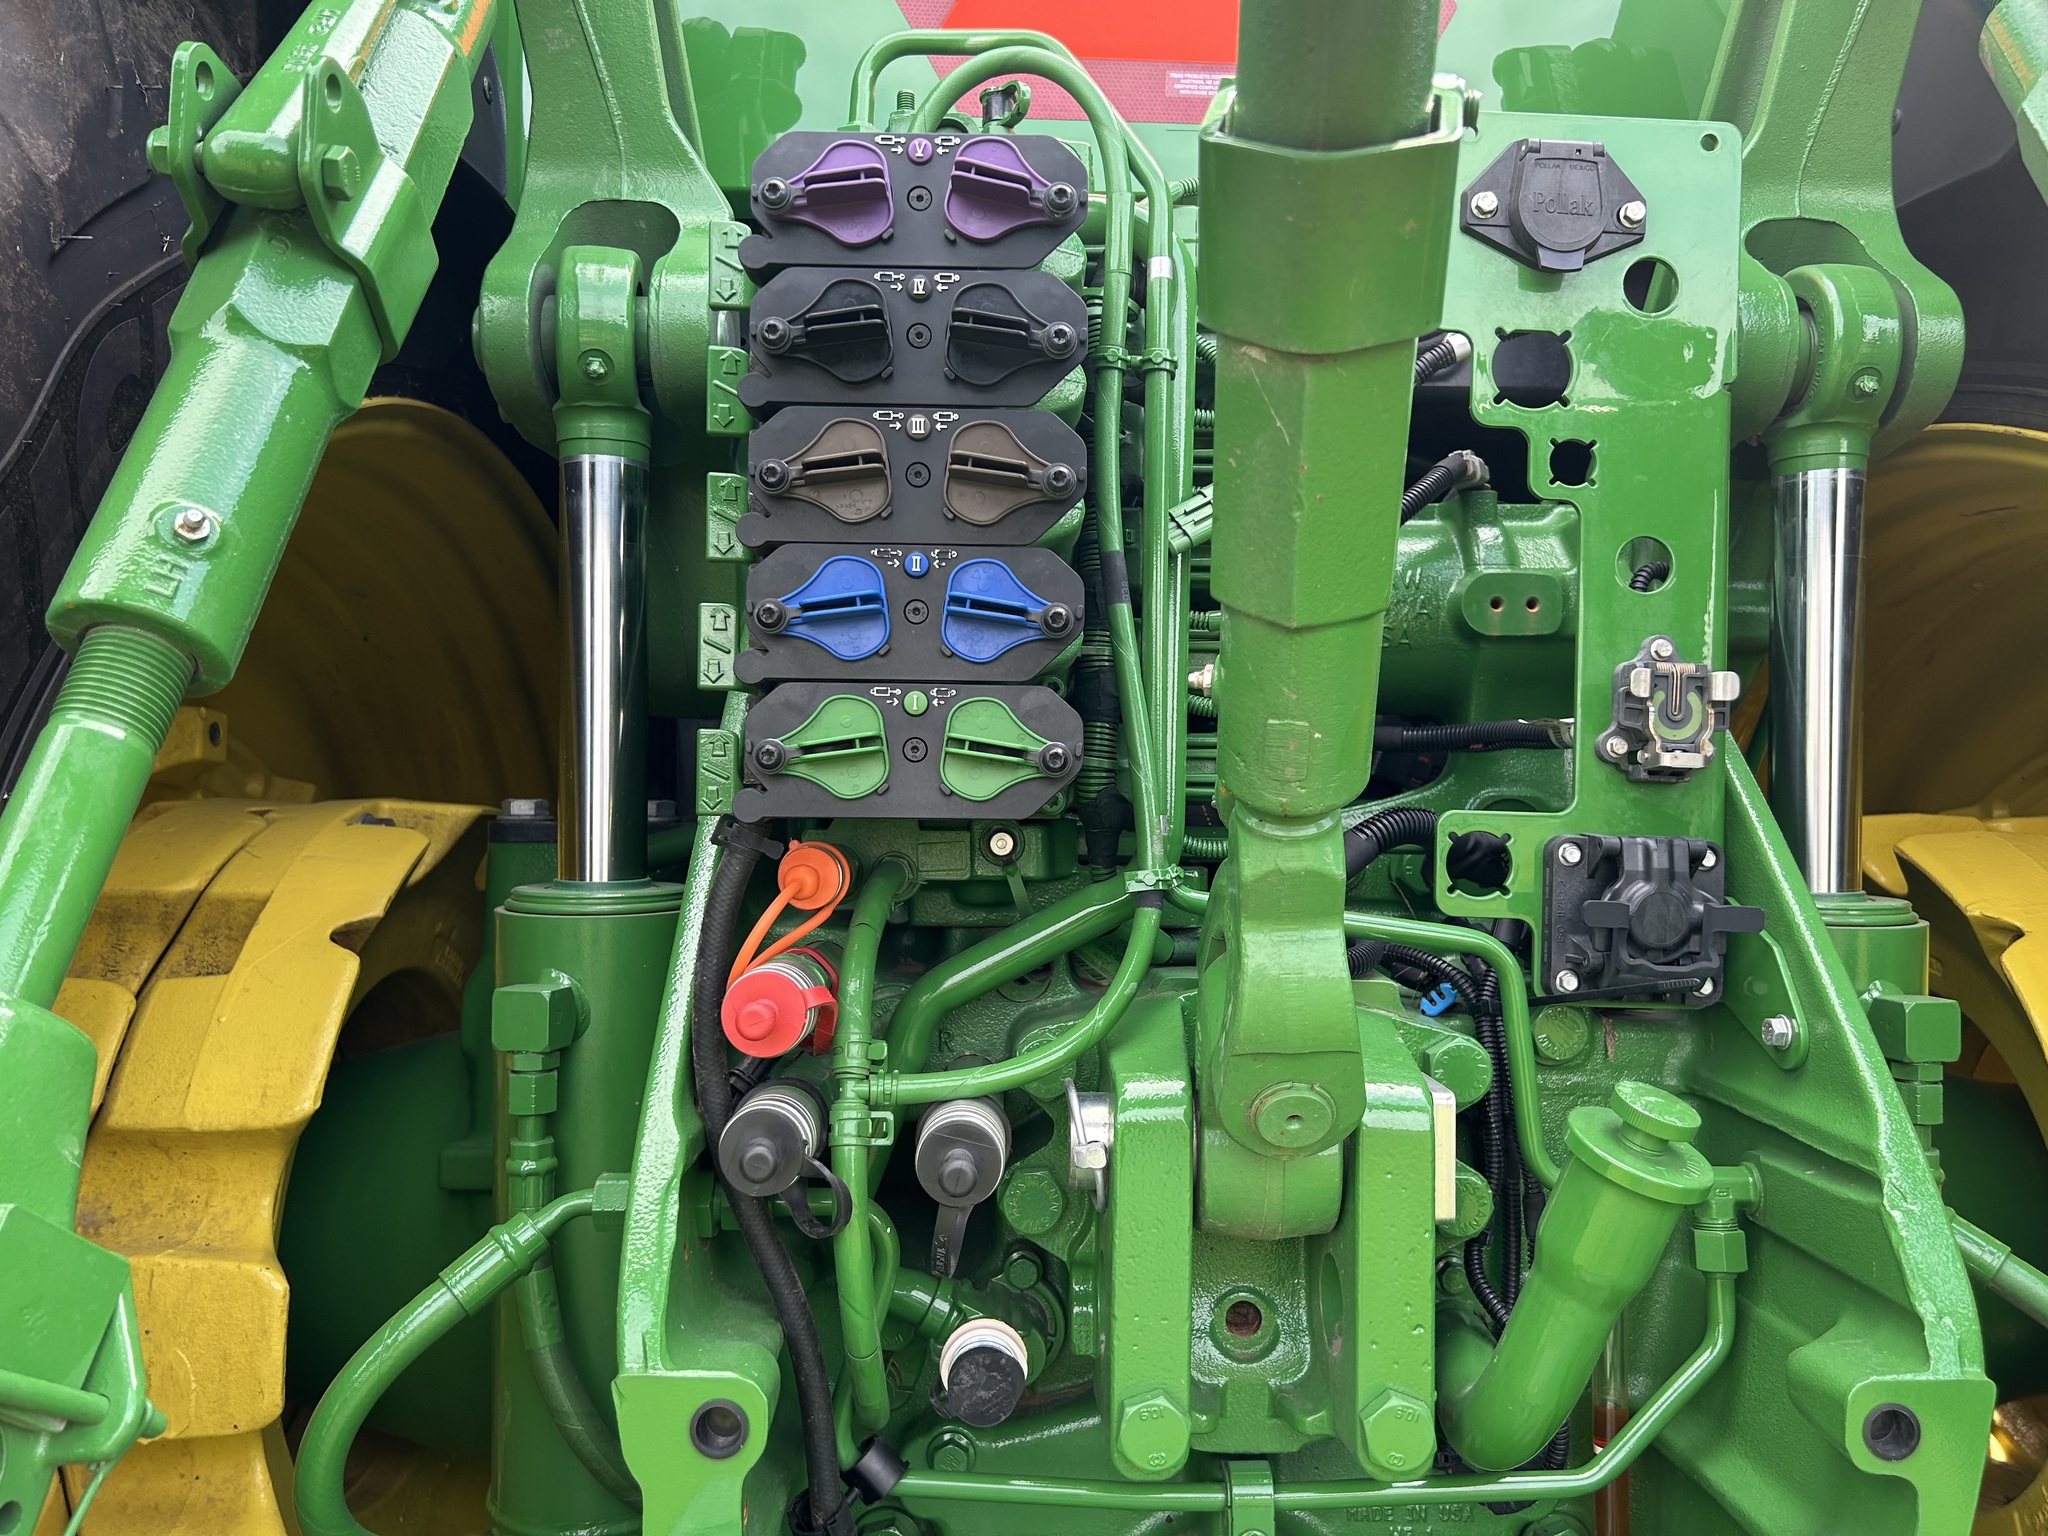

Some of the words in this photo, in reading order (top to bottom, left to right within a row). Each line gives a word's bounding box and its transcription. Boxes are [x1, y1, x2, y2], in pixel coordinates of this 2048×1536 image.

[914, 141, 927, 157] V
[1534, 162, 1561, 170] POLLAK
[1569, 164, 1596, 172] MEXICO
[1532, 191, 1594, 217] Pollak
[913, 278, 926, 295] IV
[911, 417, 926, 434] III
[911, 555, 921, 572] II
[1346, 1505, 1395, 1523] MADE
[1404, 1504, 1428, 1523] IN
[1438, 1503, 1475, 1523] USA
